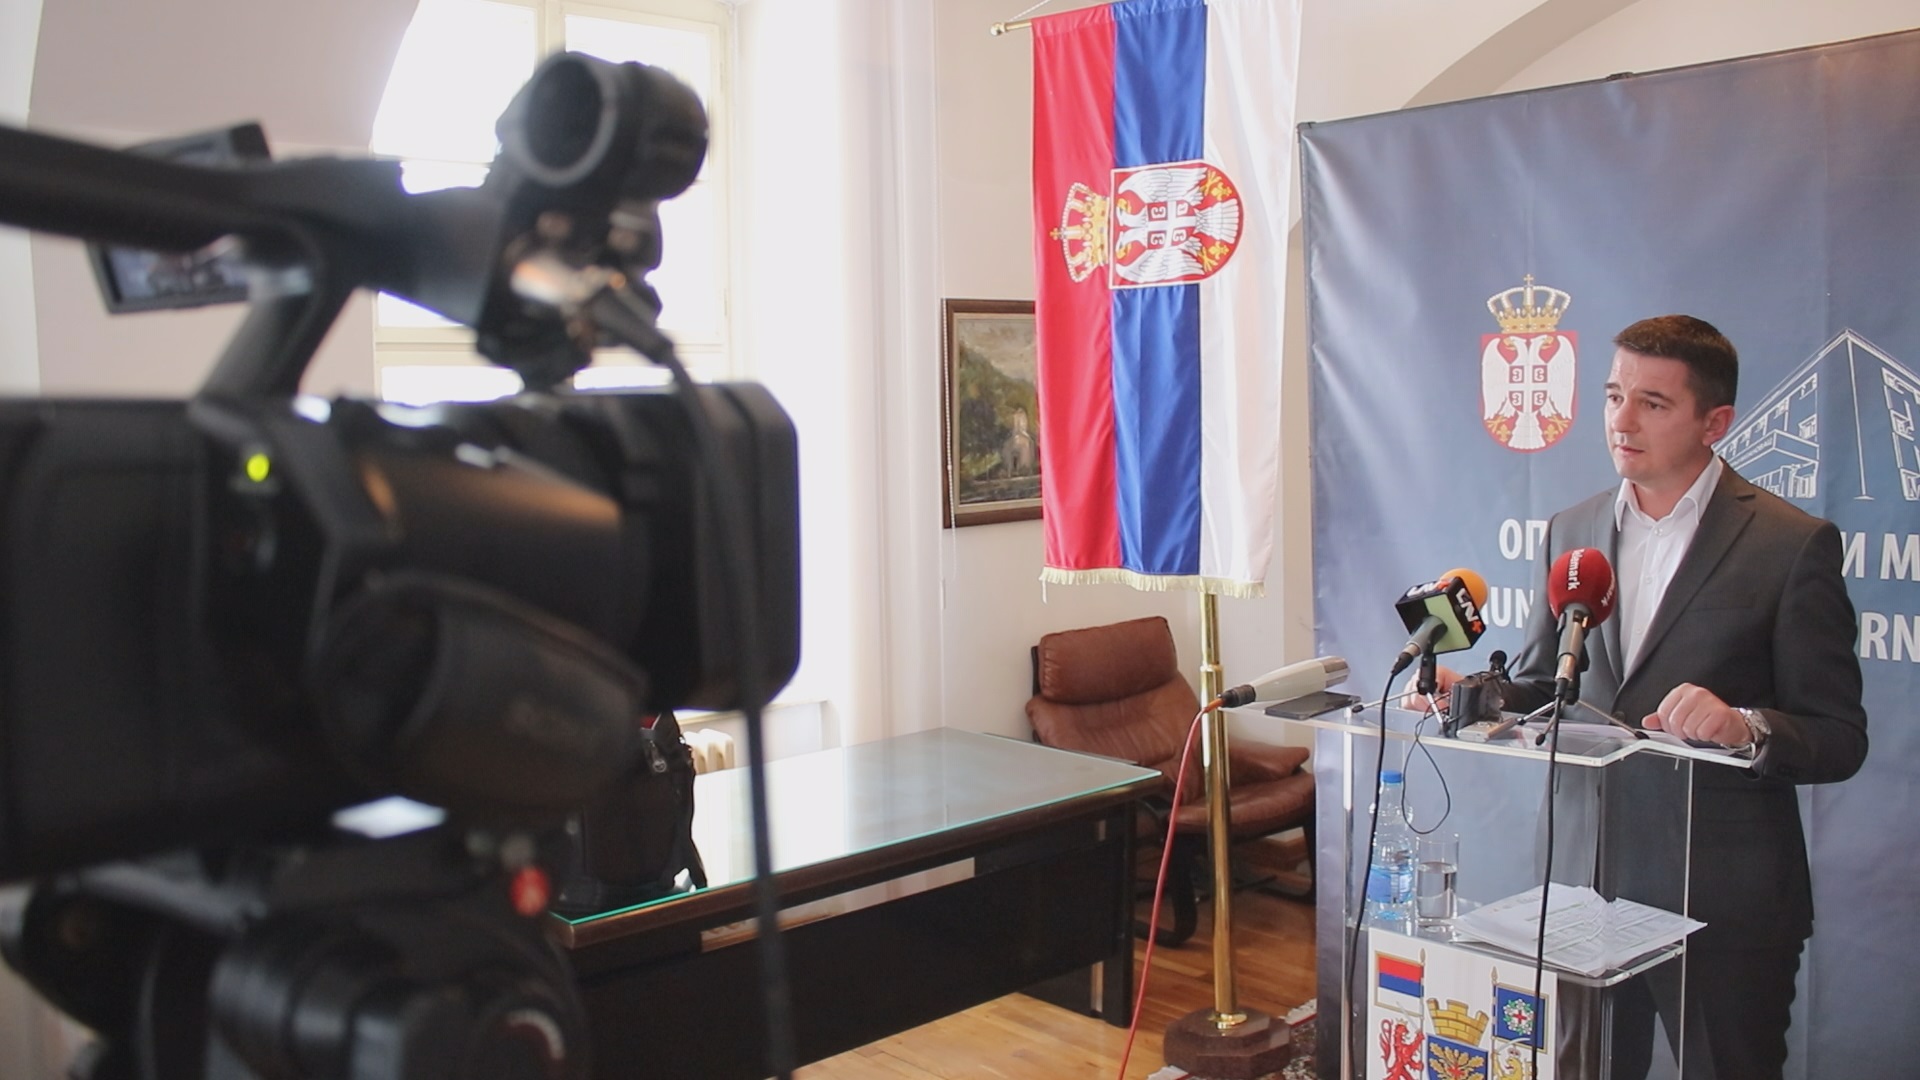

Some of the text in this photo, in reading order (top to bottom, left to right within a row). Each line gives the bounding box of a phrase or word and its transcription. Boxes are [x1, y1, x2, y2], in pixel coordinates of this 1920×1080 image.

[1499, 518, 1920, 582] ОП И М
[1480, 586, 1920, 663] UN RN
